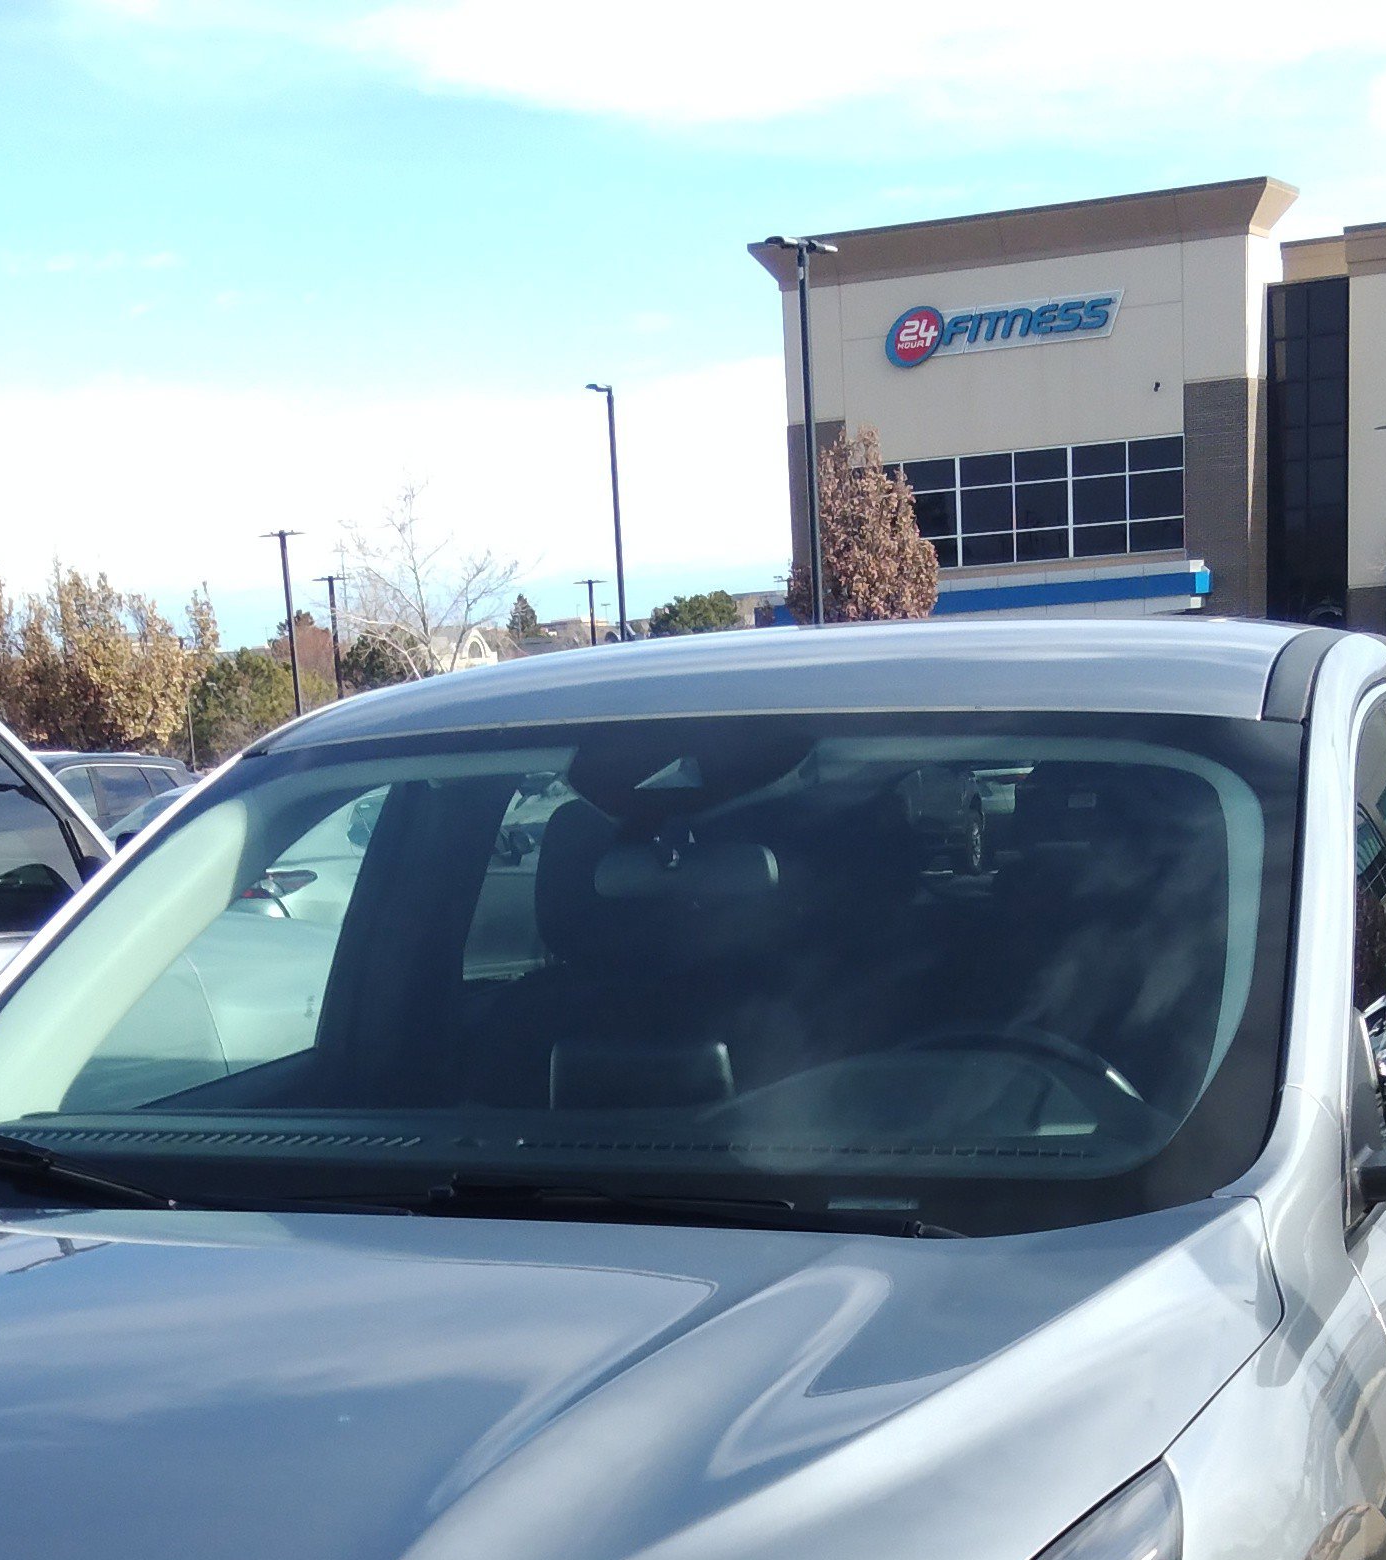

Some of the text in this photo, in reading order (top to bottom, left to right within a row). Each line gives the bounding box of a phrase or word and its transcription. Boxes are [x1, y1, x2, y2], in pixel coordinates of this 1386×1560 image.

[899, 319, 939, 347] 24
[942, 297, 1114, 346] FITNESS
[897, 339, 925, 351] HOUR
